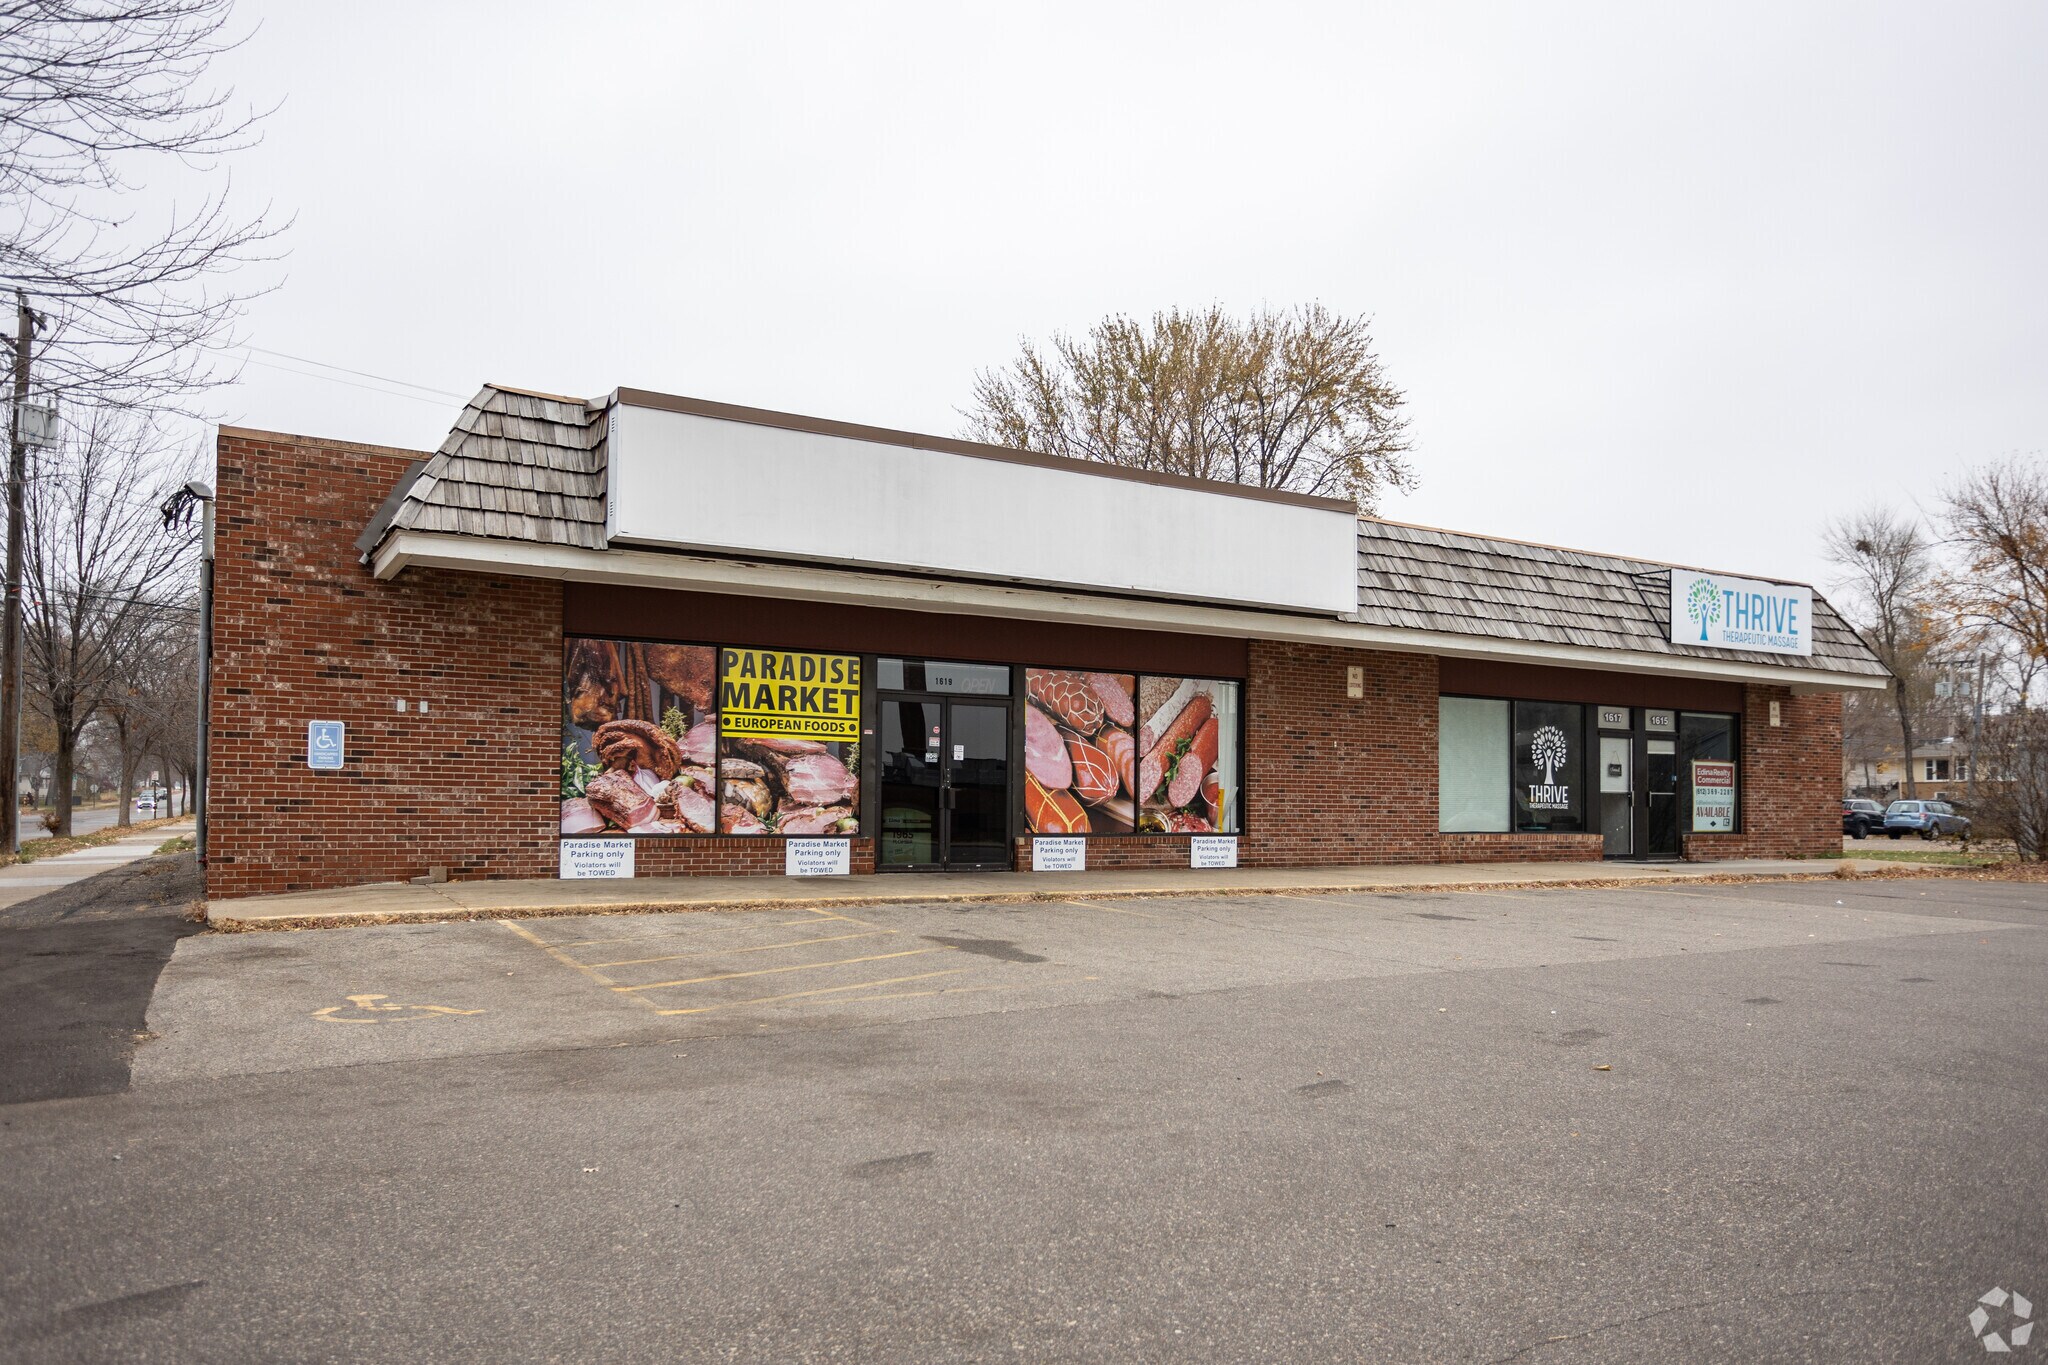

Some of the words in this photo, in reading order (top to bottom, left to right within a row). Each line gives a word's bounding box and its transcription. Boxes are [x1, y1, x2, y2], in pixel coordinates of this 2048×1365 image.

[1722, 590, 1799, 636] THRIVE
[1722, 630, 1767, 646] THERAPEUTIC
[1767, 634, 1799, 649] MASSAGE
[723, 650, 859, 685] PARADISE
[935, 677, 953, 686] 1619
[961, 678, 996, 693] OPEN
[722, 681, 859, 715] MARKET
[1604, 713, 1623, 723] 1617
[1651, 716, 1669, 725] 1615
[734, 717, 801, 730] EUROPEAN
[804, 720, 846, 733] FOODS
[1697, 776, 1731, 784] Commercial
[1529, 784, 1569, 803] THRIVE
[1696, 806, 1731, 817] AVAILABLE
[571, 850, 604, 859] Parking
[606, 850, 625, 859] only
[794, 849, 824, 858] Parking
[825, 849, 841, 857] only
